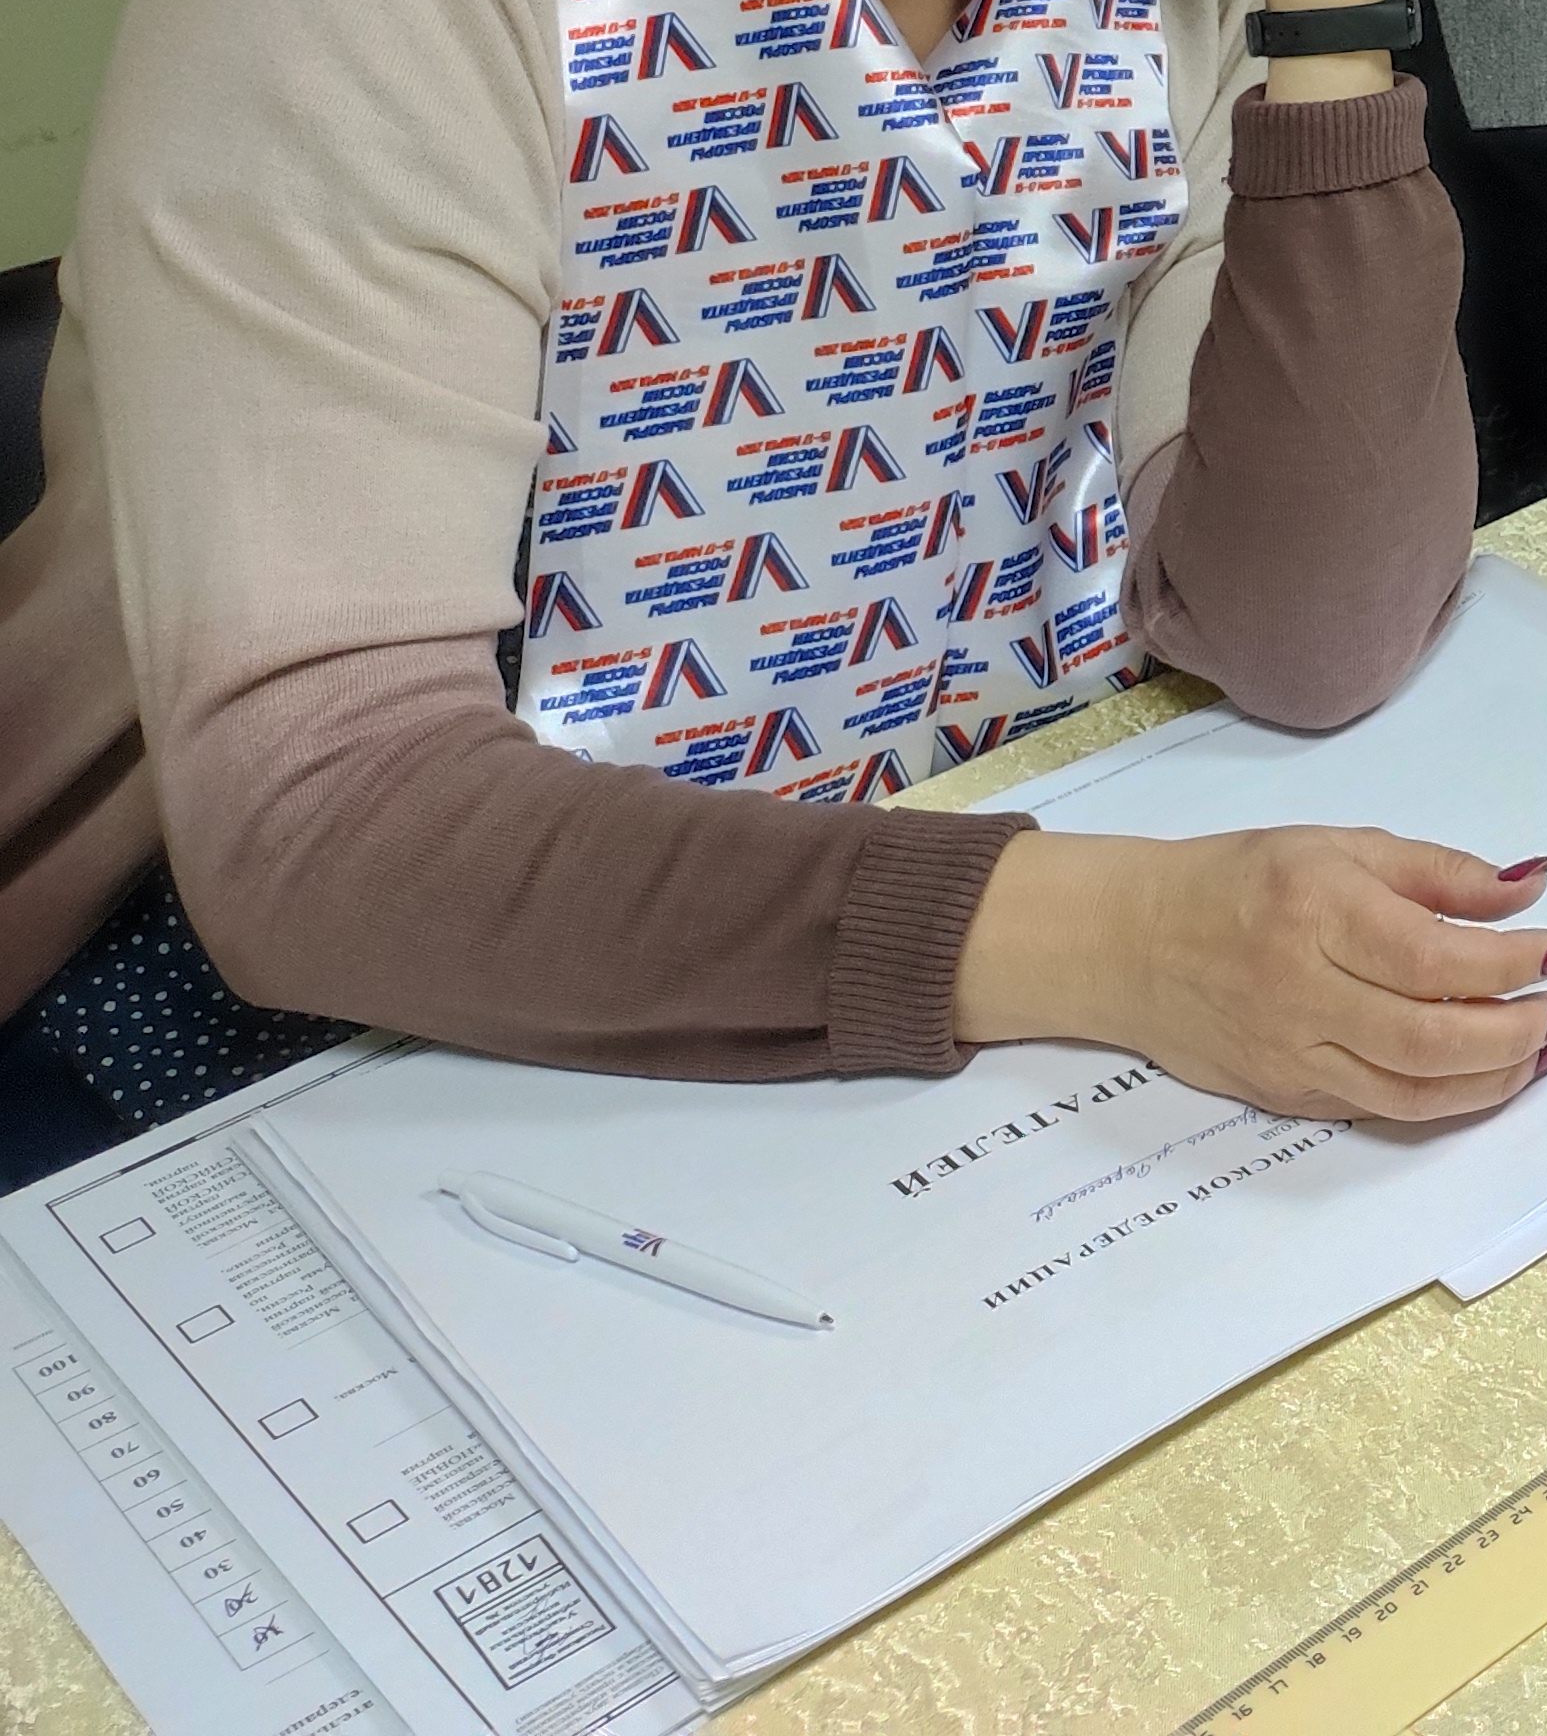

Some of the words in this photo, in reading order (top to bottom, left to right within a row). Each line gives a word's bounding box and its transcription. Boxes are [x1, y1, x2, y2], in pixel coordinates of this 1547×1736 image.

[889, 1059, 1169, 1199] БИРАТЕЛЕЙ
[1187, 1119, 1353, 1203] ССИЙСКОЙ
[981, 1200, 1180, 1311] ФЕДЕРАЦИИ
[37, 1352, 80, 1378] 100
[65, 1383, 97, 1404] 90
[88, 1410, 118, 1432] 80
[108, 1439, 140, 1460] 70
[132, 1466, 162, 1490] 60
[155, 1497, 186, 1520] 50
[179, 1527, 210, 1550] 40
[202, 1557, 234, 1580] 30
[455, 1552, 538, 1605] 1281
[1232, 1704, 1253, 1722] 16
[1268, 1680, 1289, 1695] 17
[1306, 1652, 1326, 1671] 18
[1342, 1627, 1363, 1644] 19
[1375, 1602, 1398, 1622] 20
[1410, 1580, 1430, 1597] 21
[1442, 1554, 1466, 1574] 22
[1477, 1529, 1500, 1549] 23
[1509, 1506, 1533, 1525] 24
